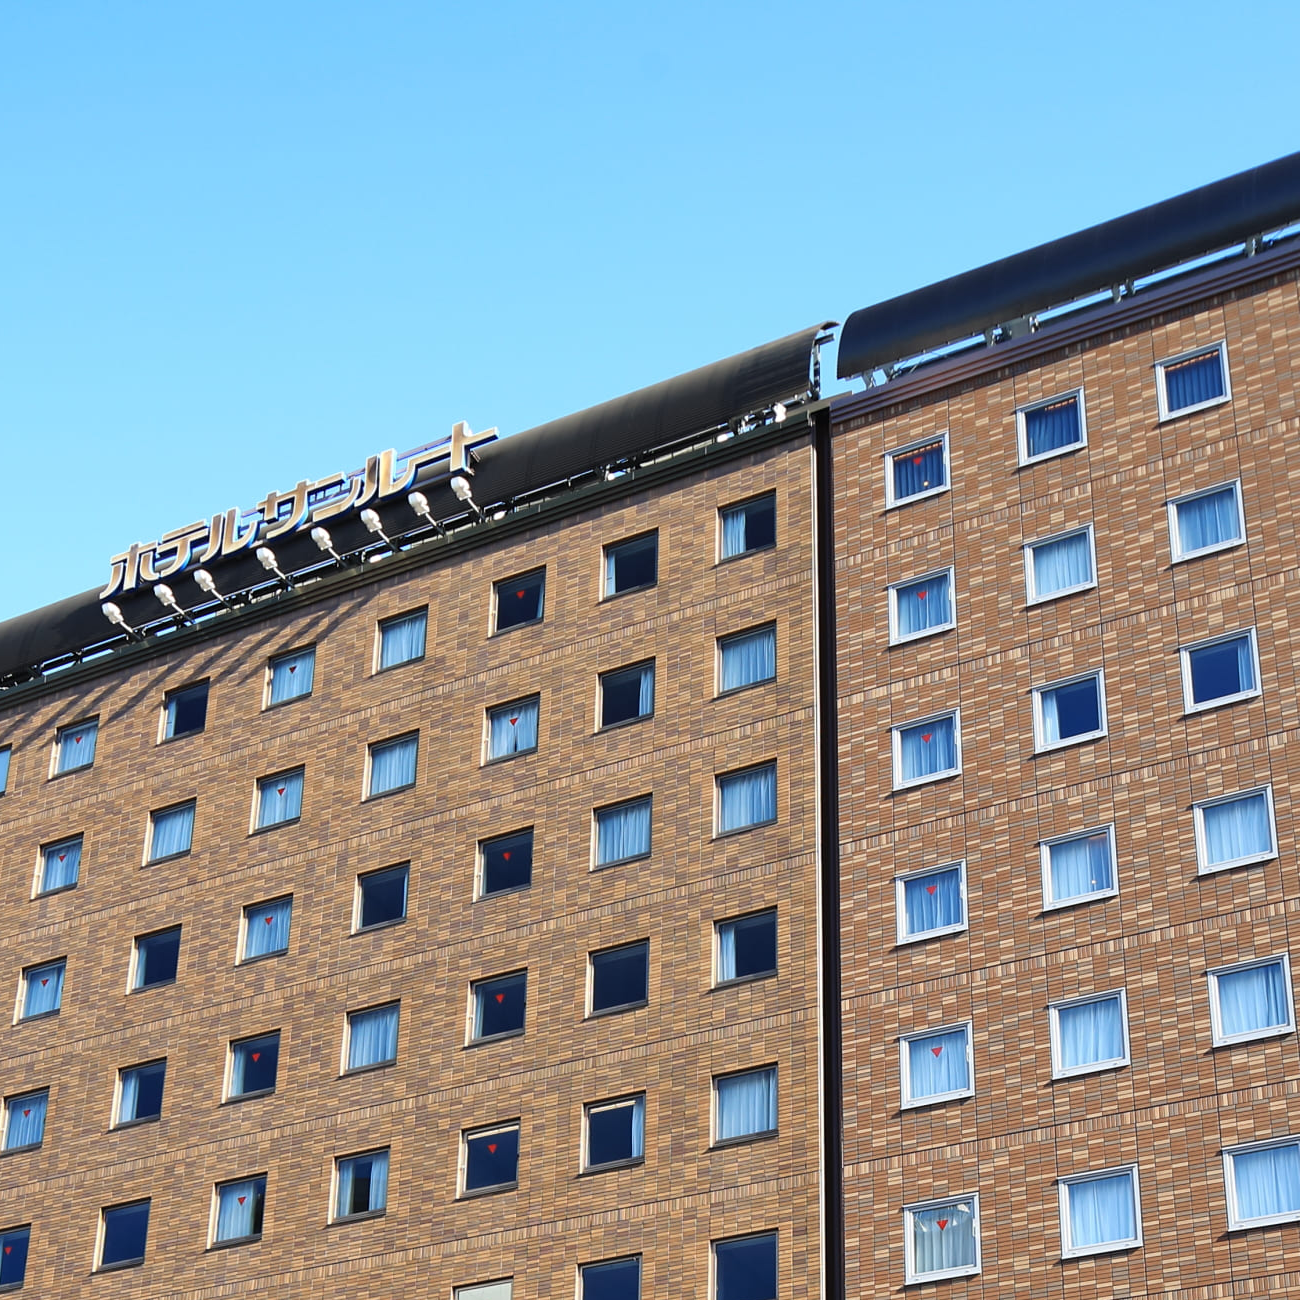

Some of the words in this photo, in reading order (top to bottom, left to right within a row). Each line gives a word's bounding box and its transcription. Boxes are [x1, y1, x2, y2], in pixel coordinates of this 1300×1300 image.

[100, 421, 499, 600] ホテルサンルート
